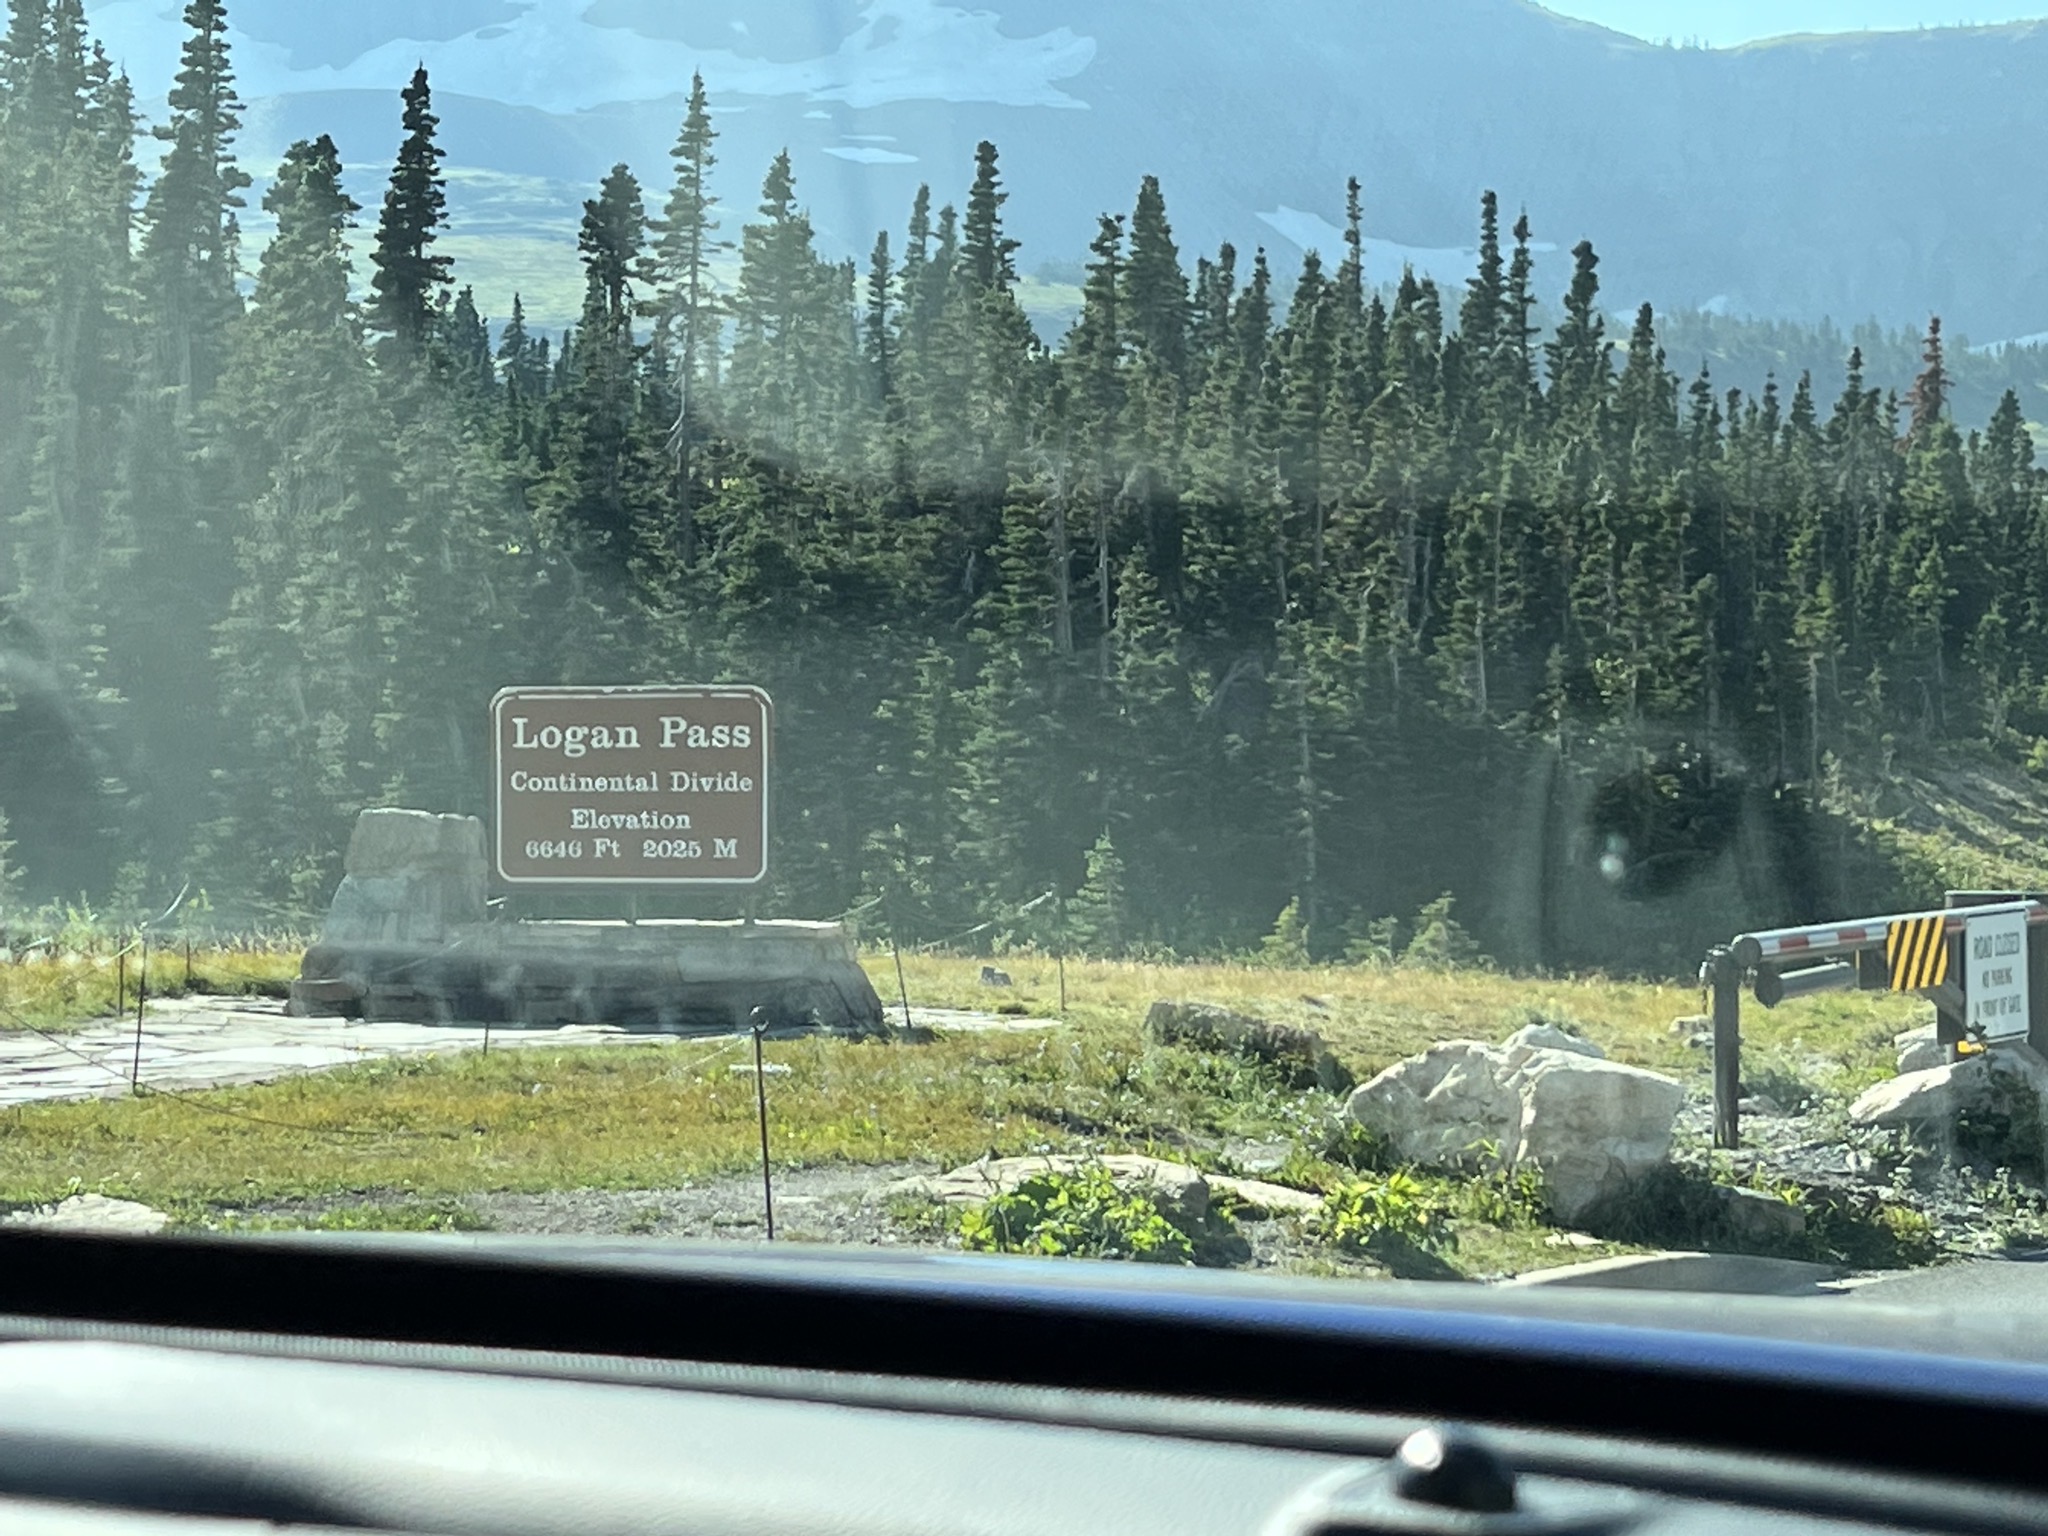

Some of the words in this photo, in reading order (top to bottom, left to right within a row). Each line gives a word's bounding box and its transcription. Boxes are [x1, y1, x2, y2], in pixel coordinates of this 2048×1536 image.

[511, 717, 640, 757] Logan
[659, 716, 750, 748] Pass
[510, 771, 658, 792] Continental
[670, 771, 753, 792] Divide
[570, 808, 691, 829] Elevation
[525, 840, 582, 858] 6646
[593, 838, 621, 858] Ft
[642, 840, 702, 858] 2025
[713, 838, 738, 858] M
[1974, 935, 1993, 960] ROAD
[1995, 932, 2020, 957] CLOSED
